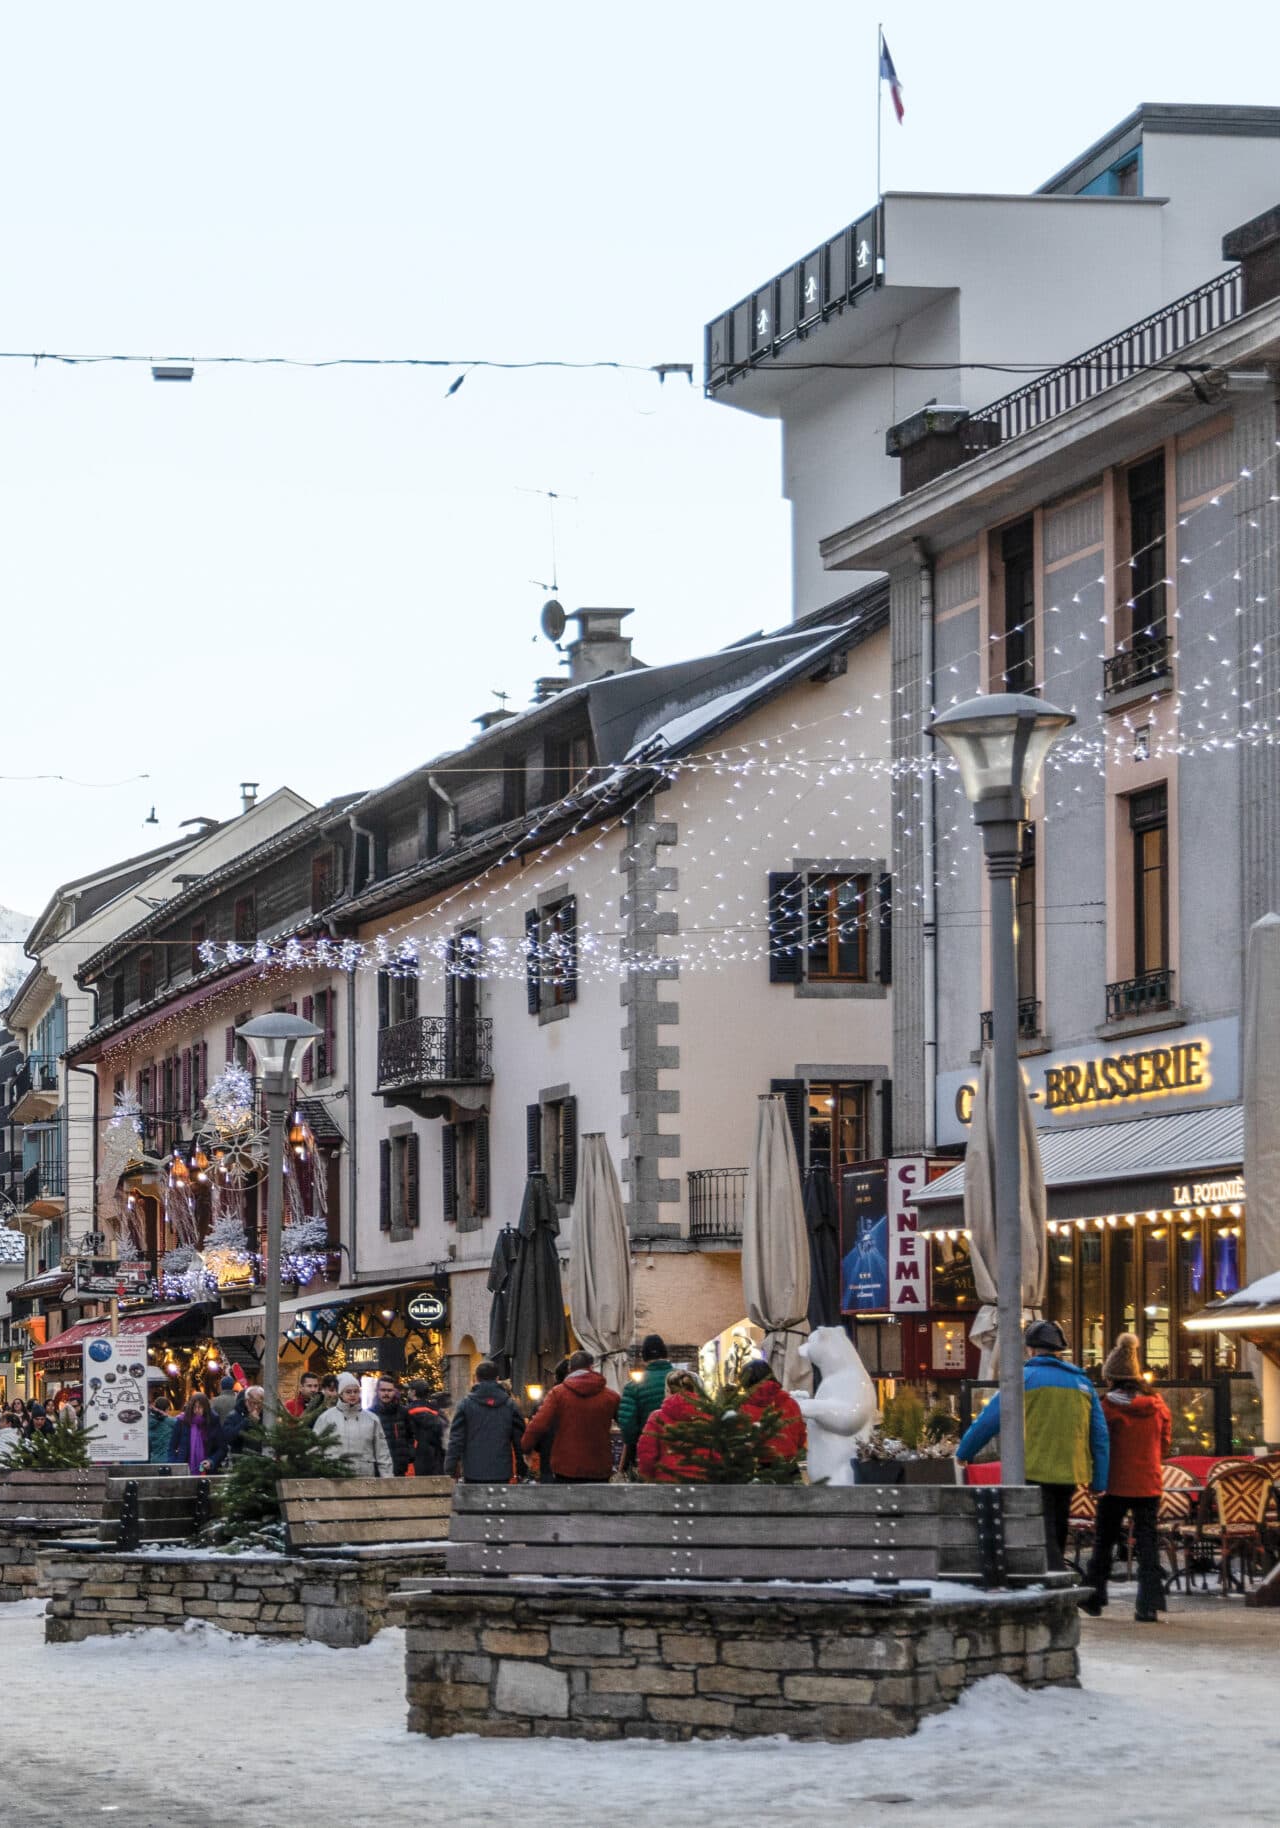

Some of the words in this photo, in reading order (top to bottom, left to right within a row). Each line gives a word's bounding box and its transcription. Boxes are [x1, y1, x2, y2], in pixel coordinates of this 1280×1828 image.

[1044, 1042, 1203, 1110] BRASSERIE
[1173, 1185, 1193, 1205] LA
[1193, 1175, 1247, 1204] POTINIÈ
